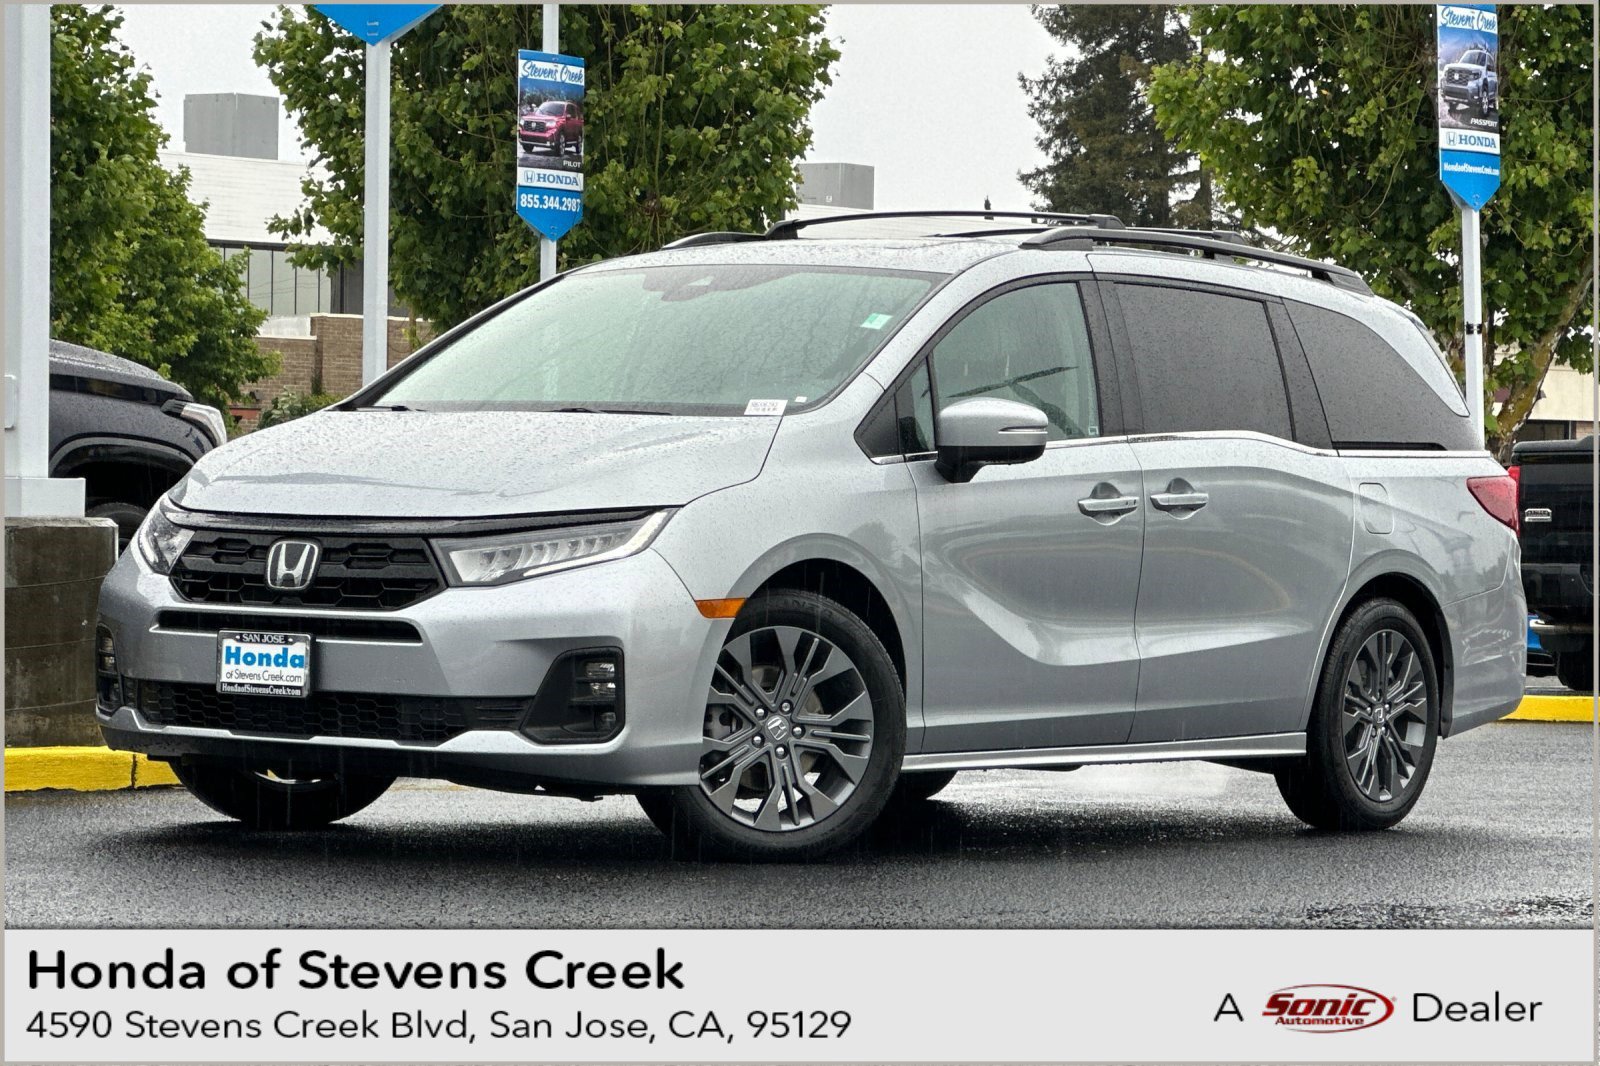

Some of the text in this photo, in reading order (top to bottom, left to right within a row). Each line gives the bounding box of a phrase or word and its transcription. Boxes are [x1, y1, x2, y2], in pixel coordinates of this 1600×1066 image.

[1441, 6, 1475, 30] Stevens
[522, 60, 584, 84] Stevens Creek
[1470, 117, 1498, 127] PASSPORT
[1458, 134, 1497, 149] HONDA
[563, 160, 582, 168] PILOT
[536, 173, 579, 186] HONDA
[520, 193, 581, 212] 855.344.2987
[242, 633, 286, 643] SAN JOSE
[225, 646, 305, 668] Honda
[225, 670, 234, 679] of
[234, 669, 261, 681] Stevens
